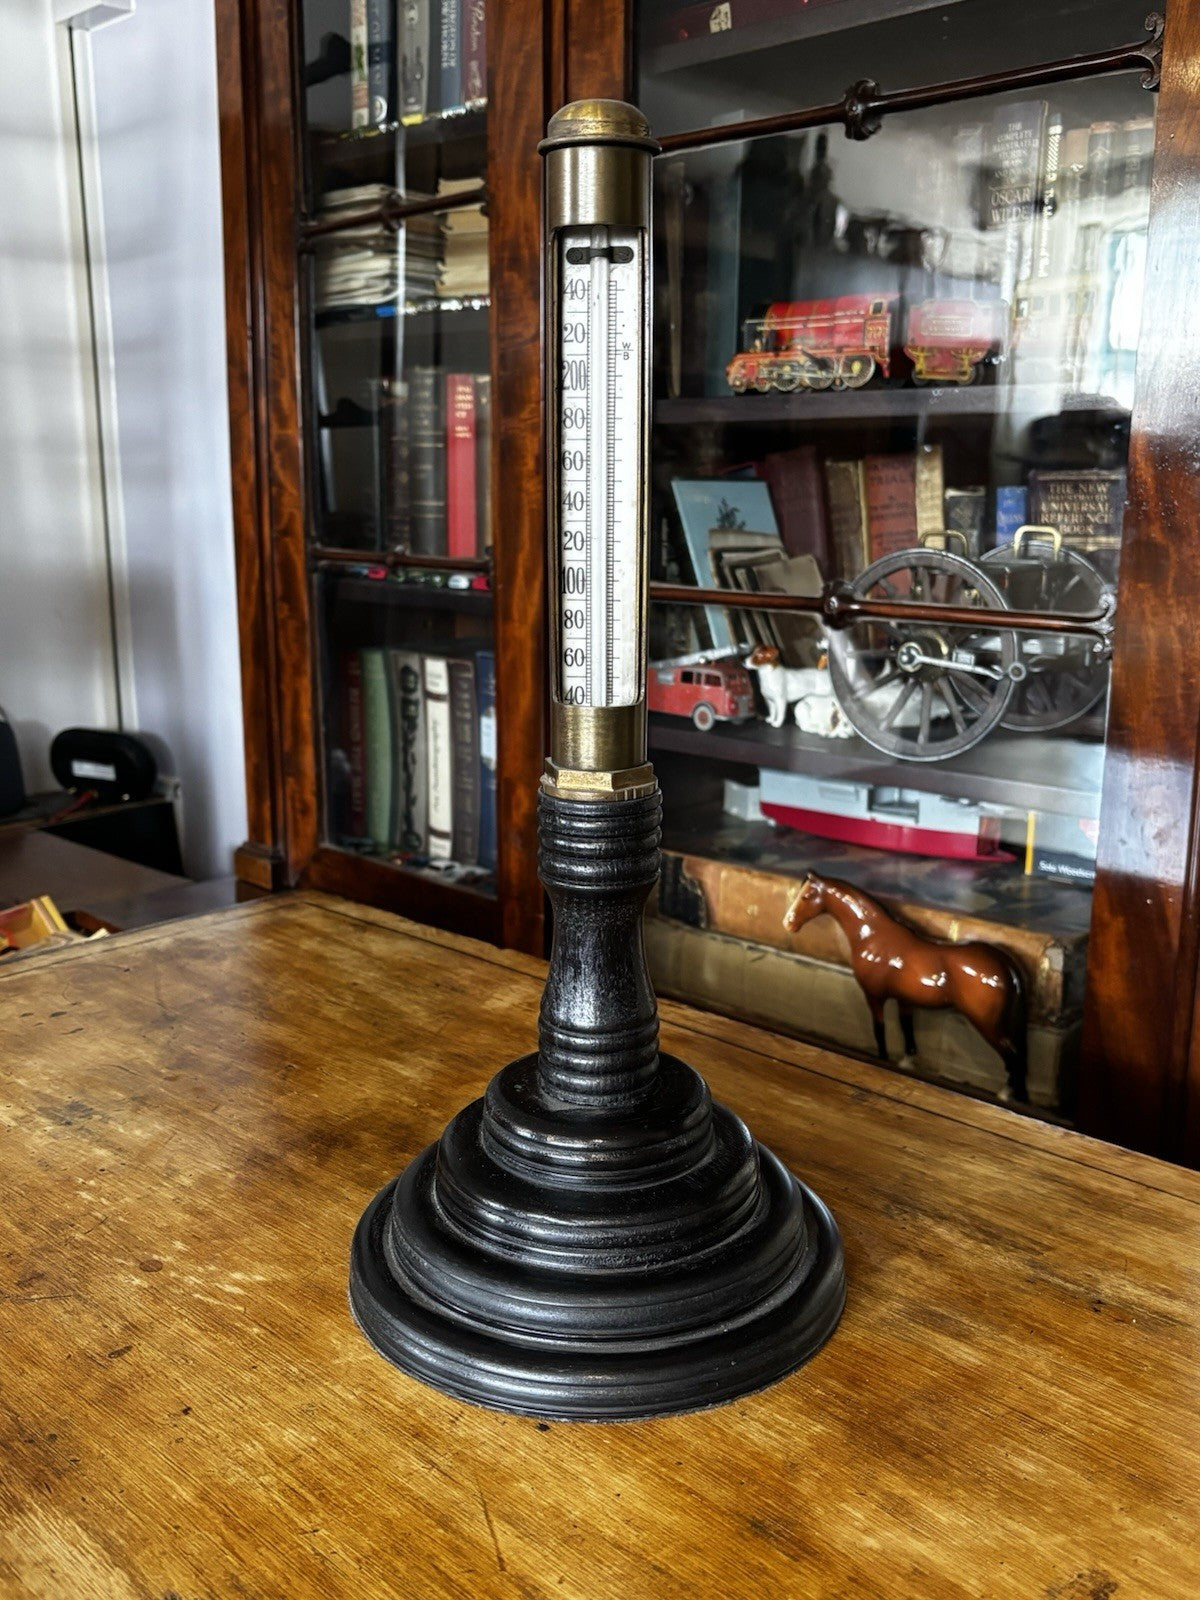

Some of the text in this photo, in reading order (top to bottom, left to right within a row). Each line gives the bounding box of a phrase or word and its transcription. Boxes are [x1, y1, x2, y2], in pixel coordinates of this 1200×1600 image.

[991, 188, 1031, 208] OSCAR
[563, 279, 586, 300] 40
[563, 323, 586, 343] 20
[562, 360, 587, 391] 200
[563, 407, 586, 430] 80
[562, 450, 584, 471] 60
[1049, 481, 1109, 494] THE NEW
[562, 490, 585, 511] 40
[1040, 501, 1112, 512] UNIVERSAL
[1040, 512, 1112, 524] REFERENCE
[1060, 524, 1096, 535] BOOK
[563, 530, 585, 551] 20
[561, 566, 585, 595] 100
[563, 609, 585, 629] 80
[563, 647, 585, 667] 60
[563, 685, 585, 705] 40
